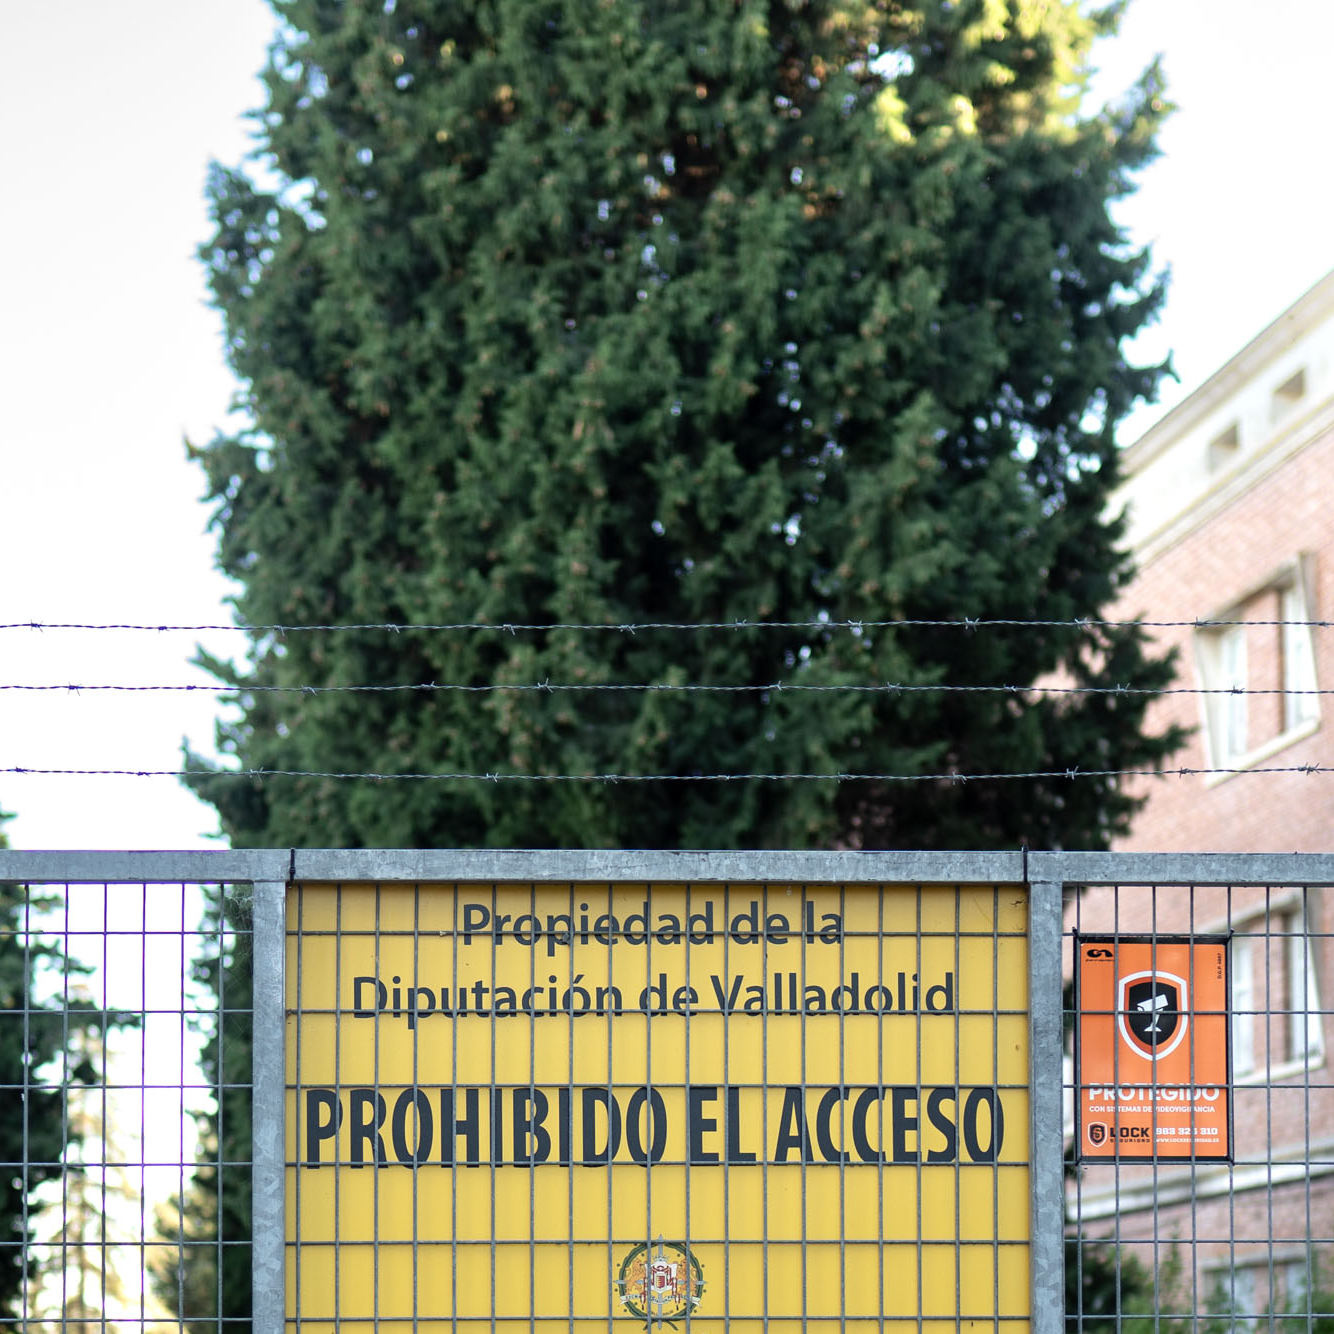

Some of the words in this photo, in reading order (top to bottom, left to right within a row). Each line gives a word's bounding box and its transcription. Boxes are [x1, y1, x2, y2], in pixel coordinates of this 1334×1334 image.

[463, 901, 714, 957] Propiedad
[730, 901, 790, 945] de
[806, 901, 843, 945] la
[353, 974, 623, 1030] Diputación
[639, 973, 698, 1017] de
[710, 972, 954, 1017] Valladolid
[1089, 1082, 1220, 1101] PROTEGIDO
[306, 1087, 667, 1169] PROHIBIDO
[689, 1087, 756, 1167] EL
[774, 1087, 1005, 1165] ACCESO
[1109, 1127, 1150, 1138] LOCK
[1200, 1127, 1219, 1135] 310
